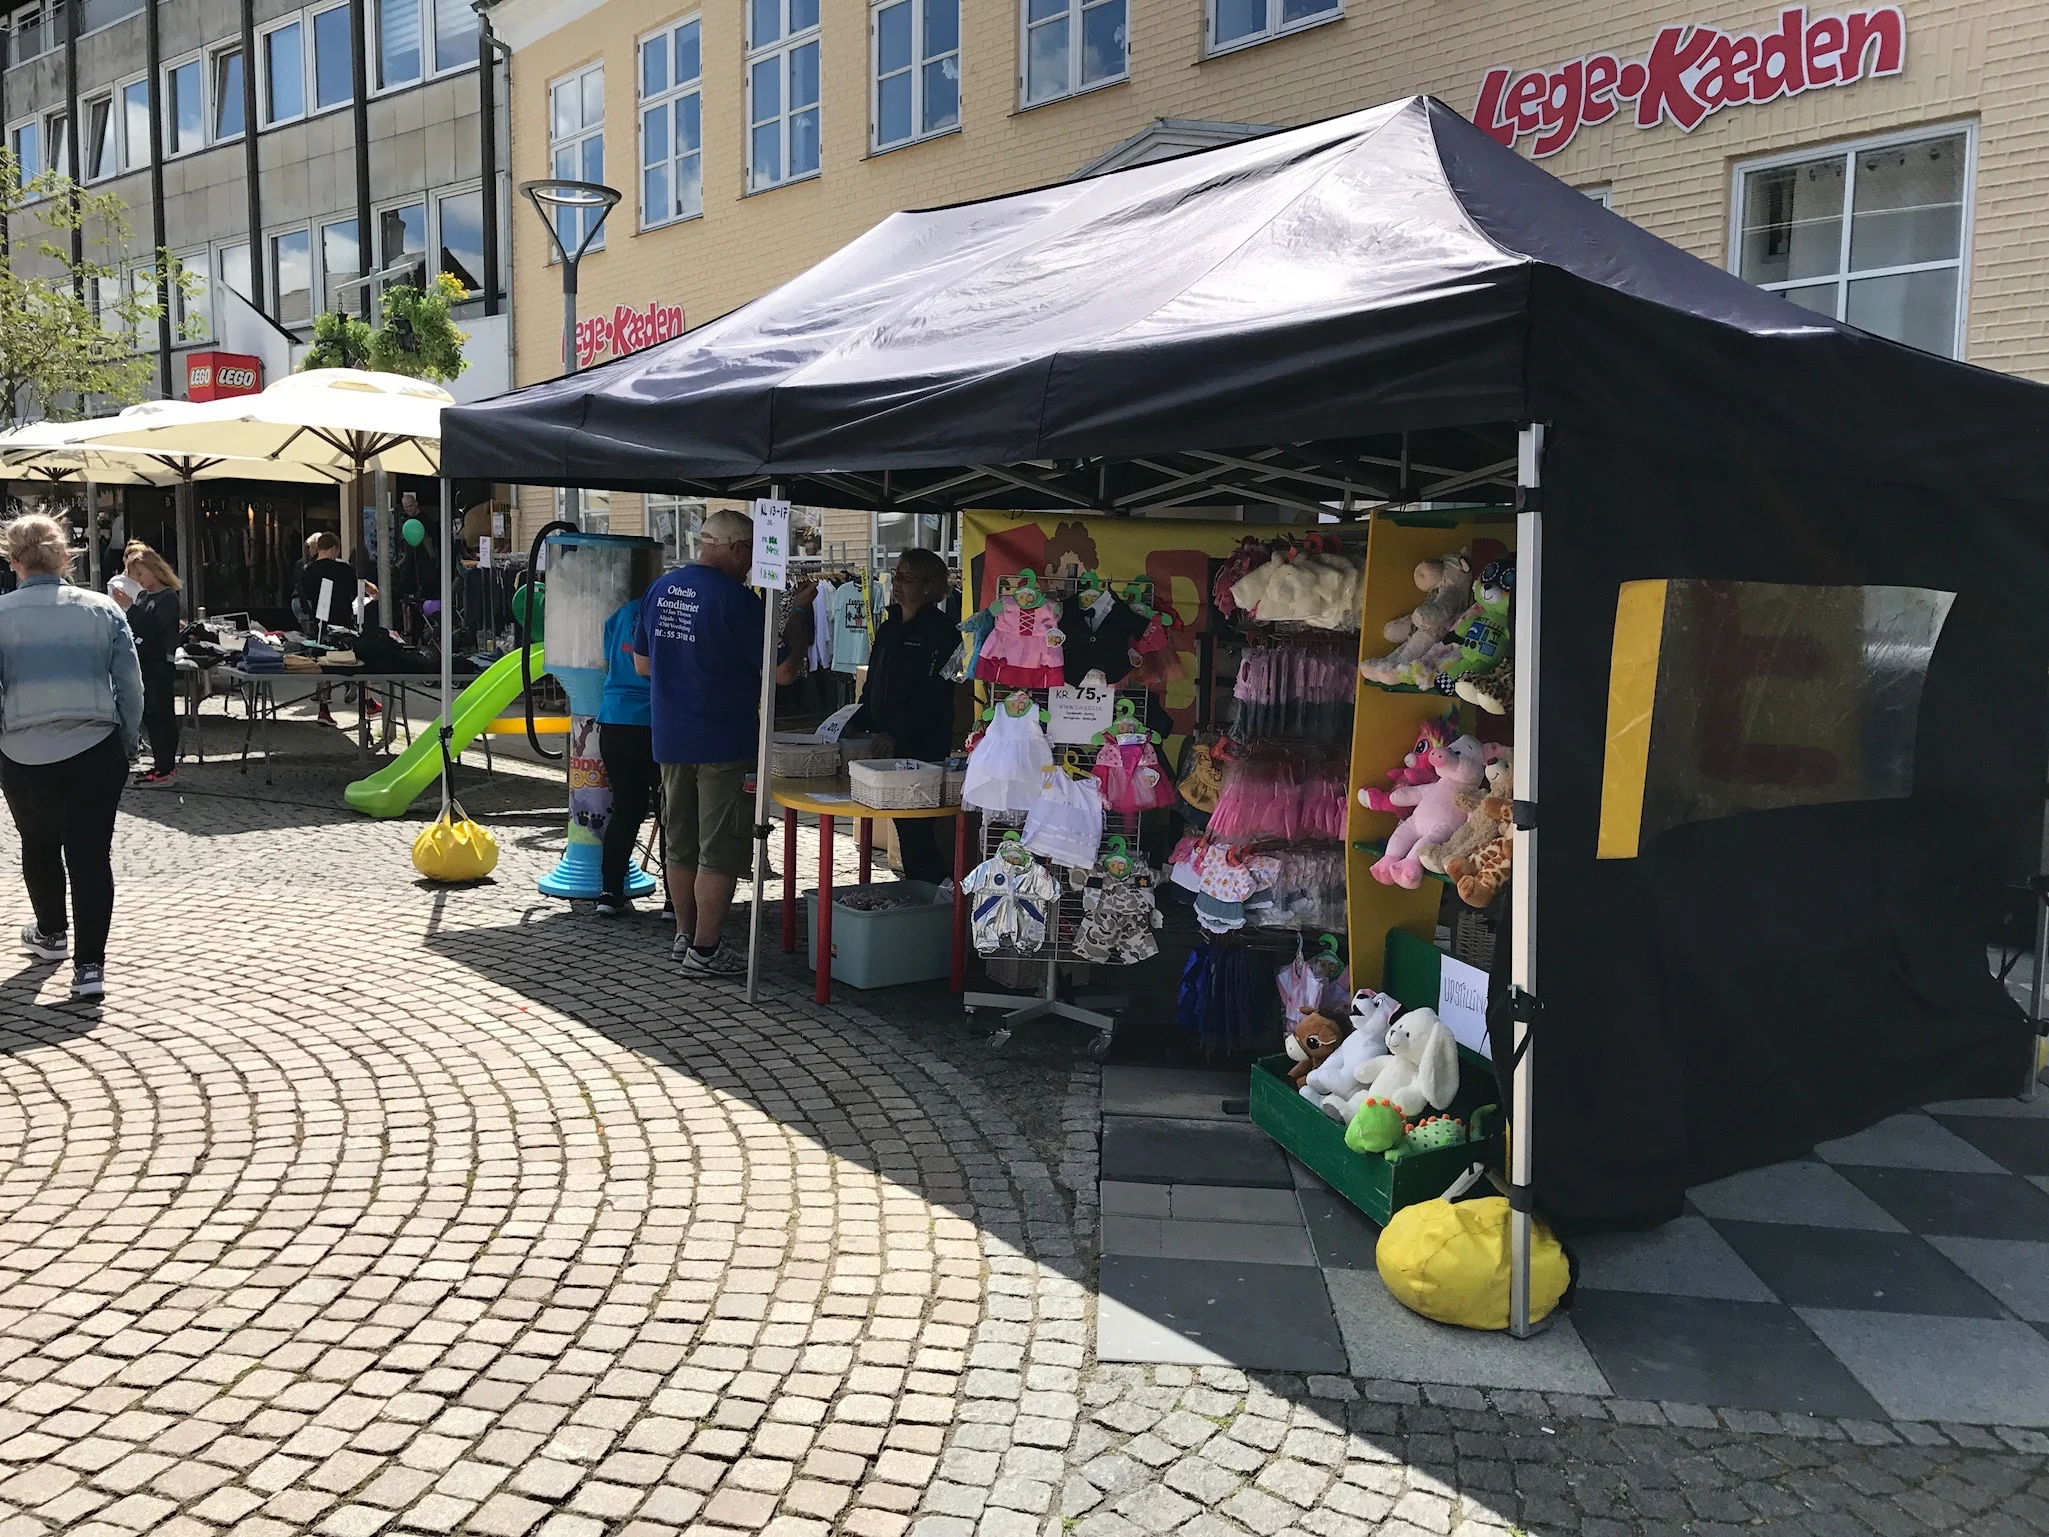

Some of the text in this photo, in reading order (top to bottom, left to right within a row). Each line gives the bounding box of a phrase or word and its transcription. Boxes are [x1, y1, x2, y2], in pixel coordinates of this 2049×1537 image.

[190, 367, 211, 386] LEGO
[218, 368, 254, 388] LEGO
[667, 585, 697, 598] Othello
[656, 597, 700, 613] Konditoriet
[1055, 687, 1107, 704] KR. 75,-
[570, 756, 603, 771] EDDY
